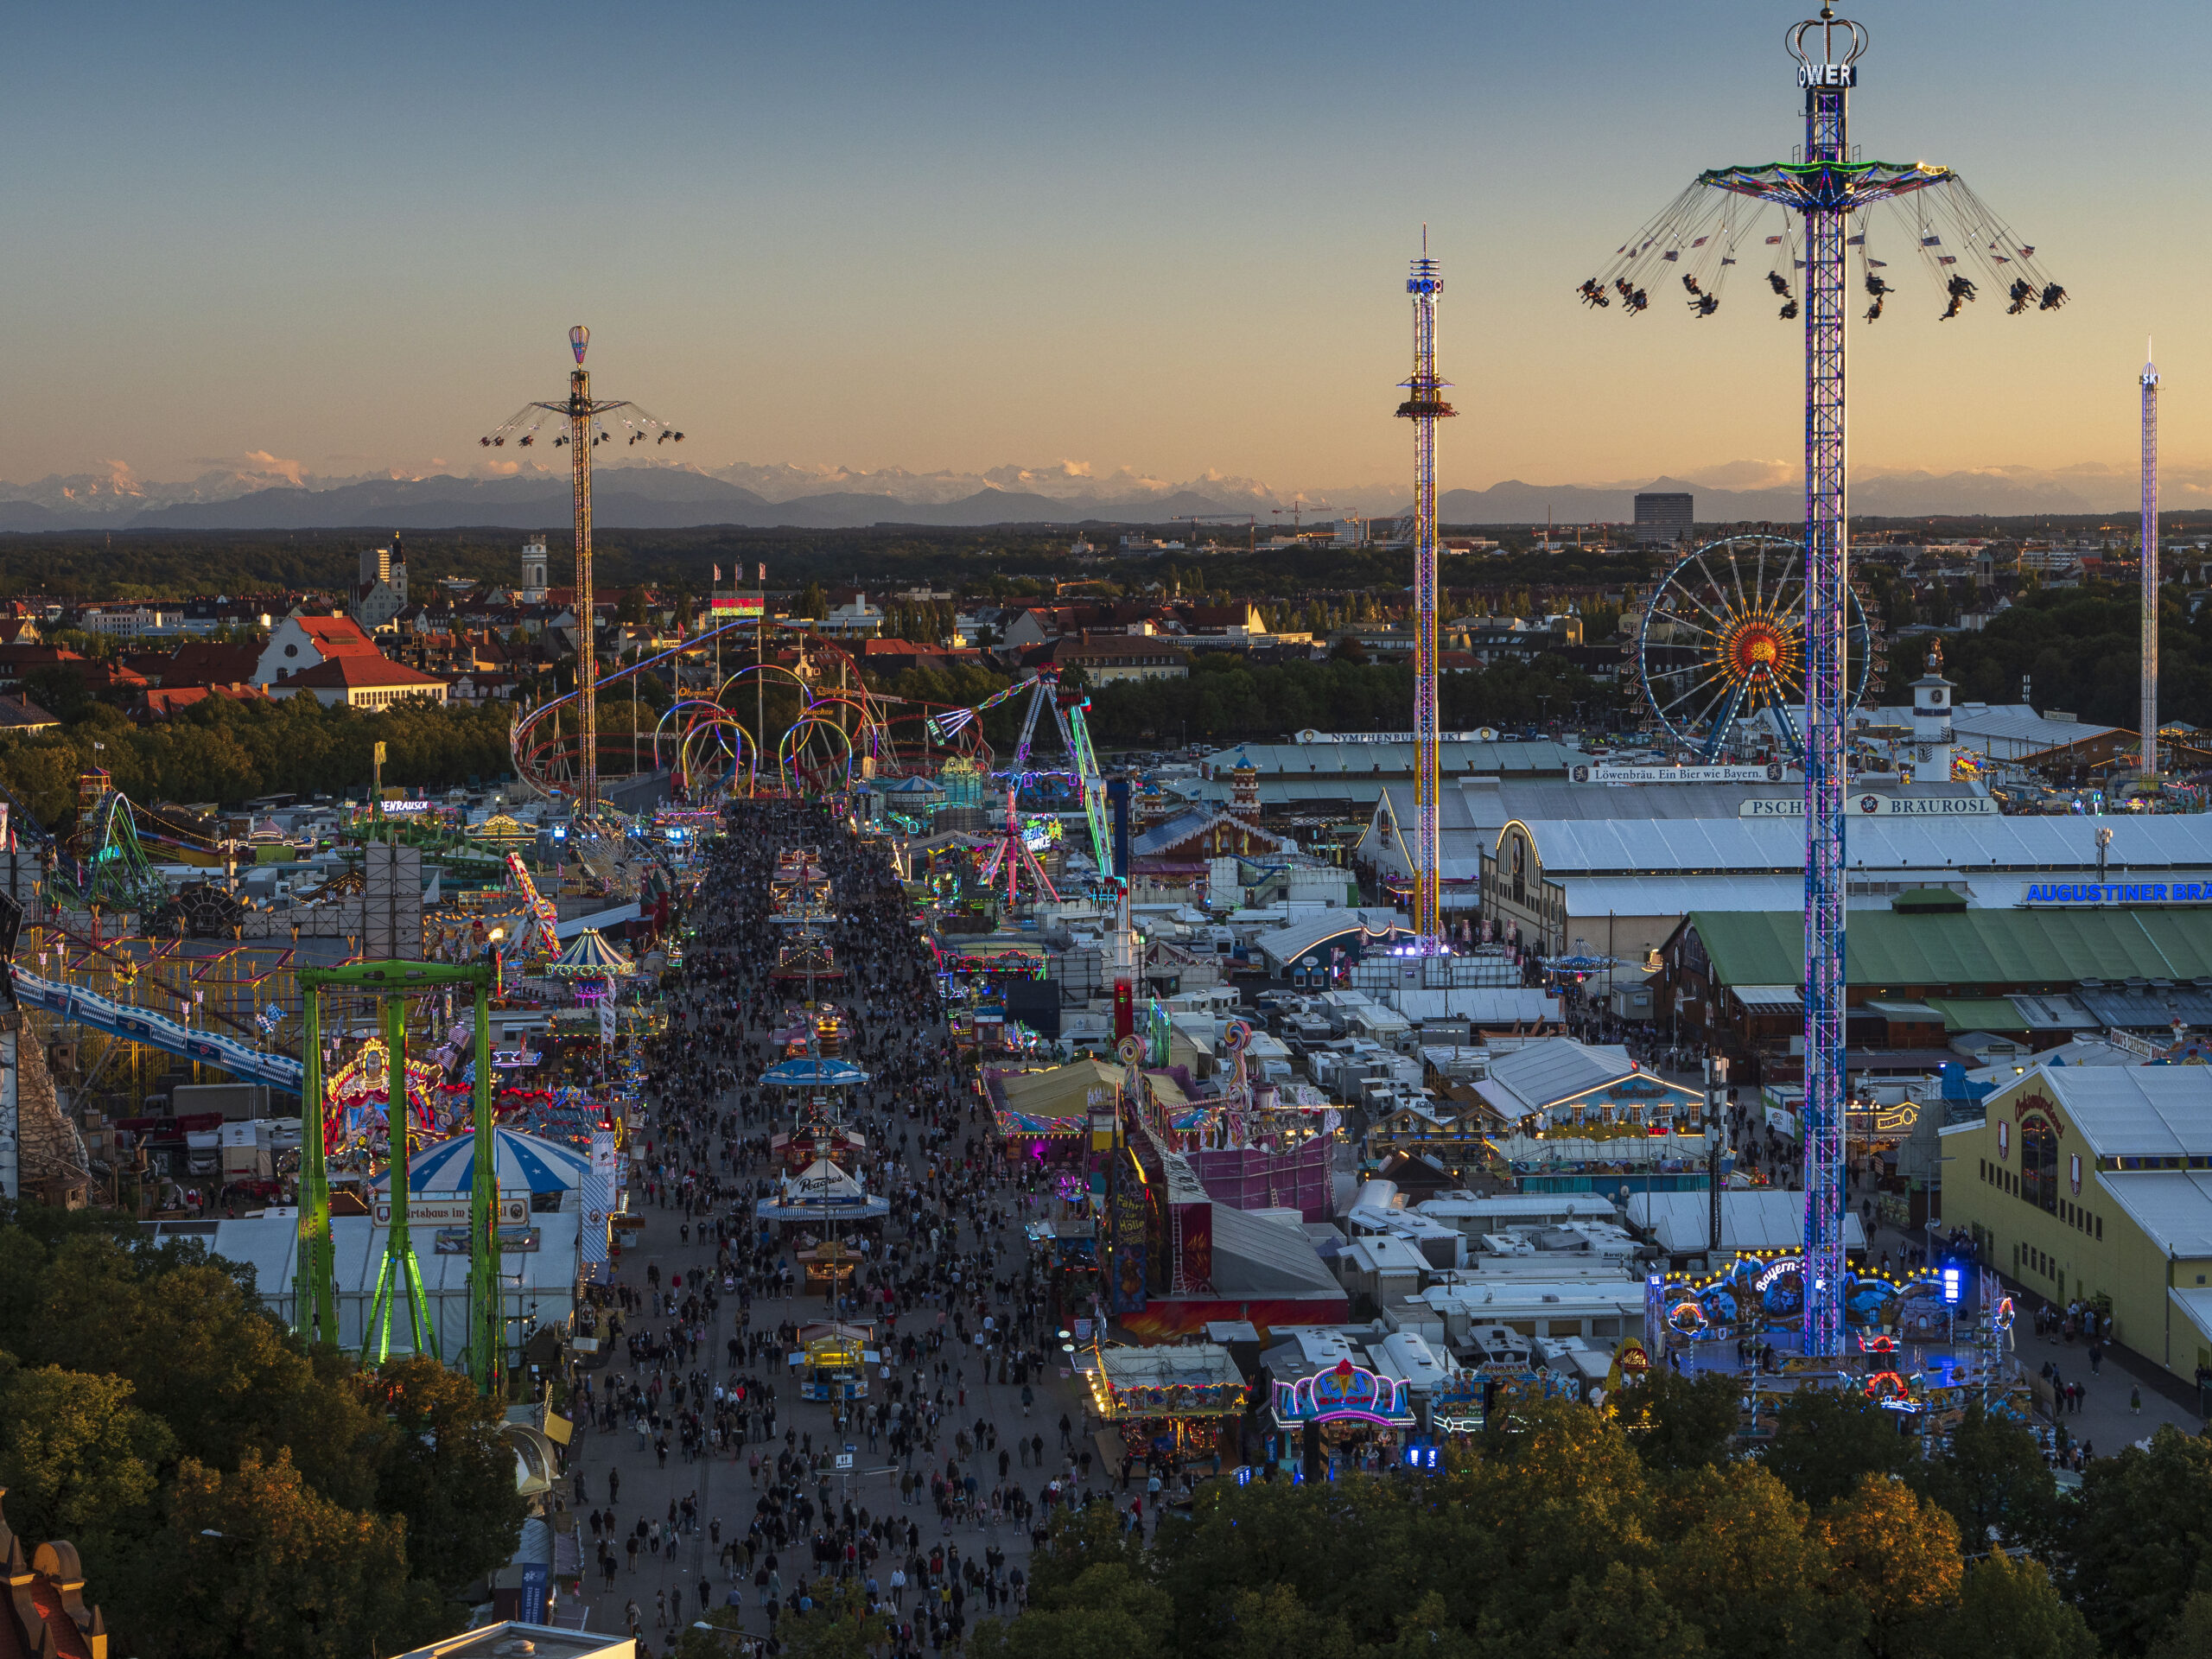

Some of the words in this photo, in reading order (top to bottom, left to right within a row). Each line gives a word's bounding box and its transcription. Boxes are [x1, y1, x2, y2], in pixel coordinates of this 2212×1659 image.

[678, 686, 715, 697] Olympia
[817, 685, 853, 696] Looping
[798, 706, 835, 716] München
[1332, 733, 1416, 742] NYMPHENBUR
[1440, 733, 1464, 741] EKT
[1595, 768, 1656, 780] Löwenbräu.
[1659, 768, 1676, 779] Ein
[1680, 768, 1700, 779] Bier
[1703, 771, 1721, 779] wie
[1724, 767, 1762, 782] Bayern.
[1752, 800, 1803, 814] PSCH
[1891, 798, 1990, 814] BRÄUROSL
[2026, 883, 2168, 902] AUGUSTINER
[799, 1174, 843, 1193] Peaches
[1116, 1193, 1146, 1211] Fahrt
[407, 1206, 449, 1220] irtshaus
[1118, 1218, 1146, 1231] Hölle
[1319, 1395, 1373, 1406] SHOP
